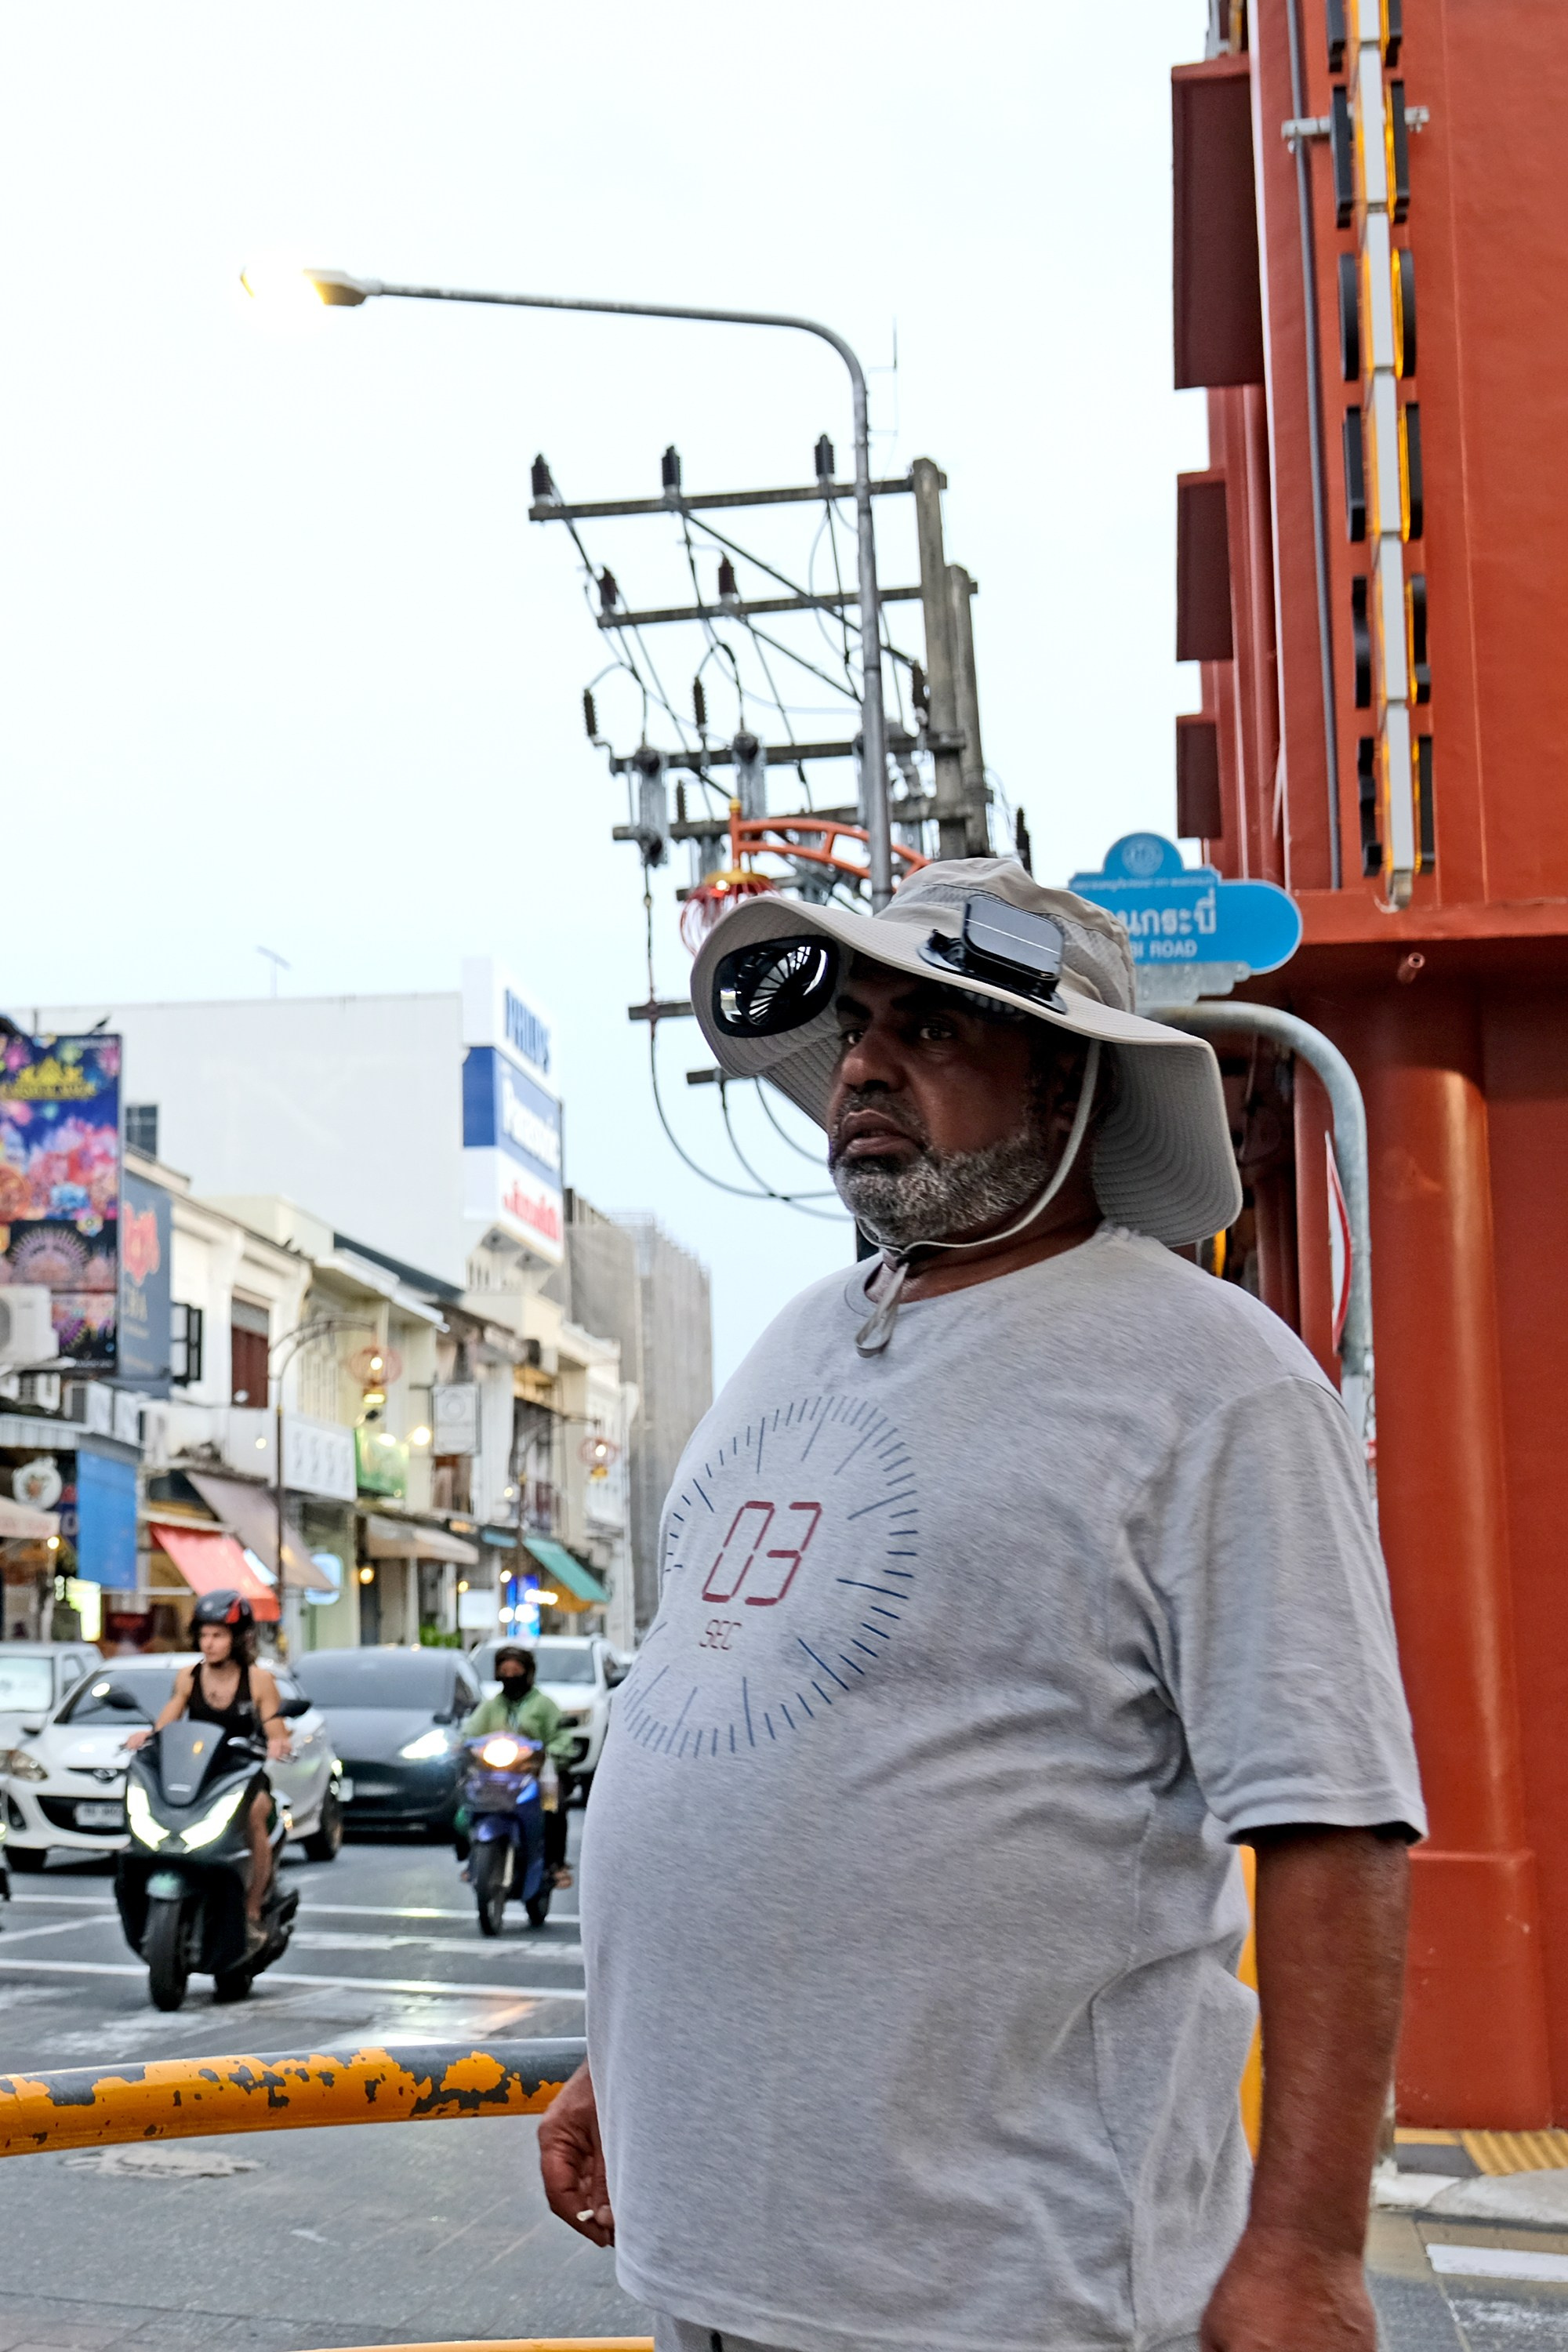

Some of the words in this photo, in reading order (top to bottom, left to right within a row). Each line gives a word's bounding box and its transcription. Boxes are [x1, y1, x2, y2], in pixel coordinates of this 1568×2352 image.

[1149, 938, 1198, 958] ROAD
[702, 1501, 822, 1606] 03
[699, 1619, 743, 1651] SEC
